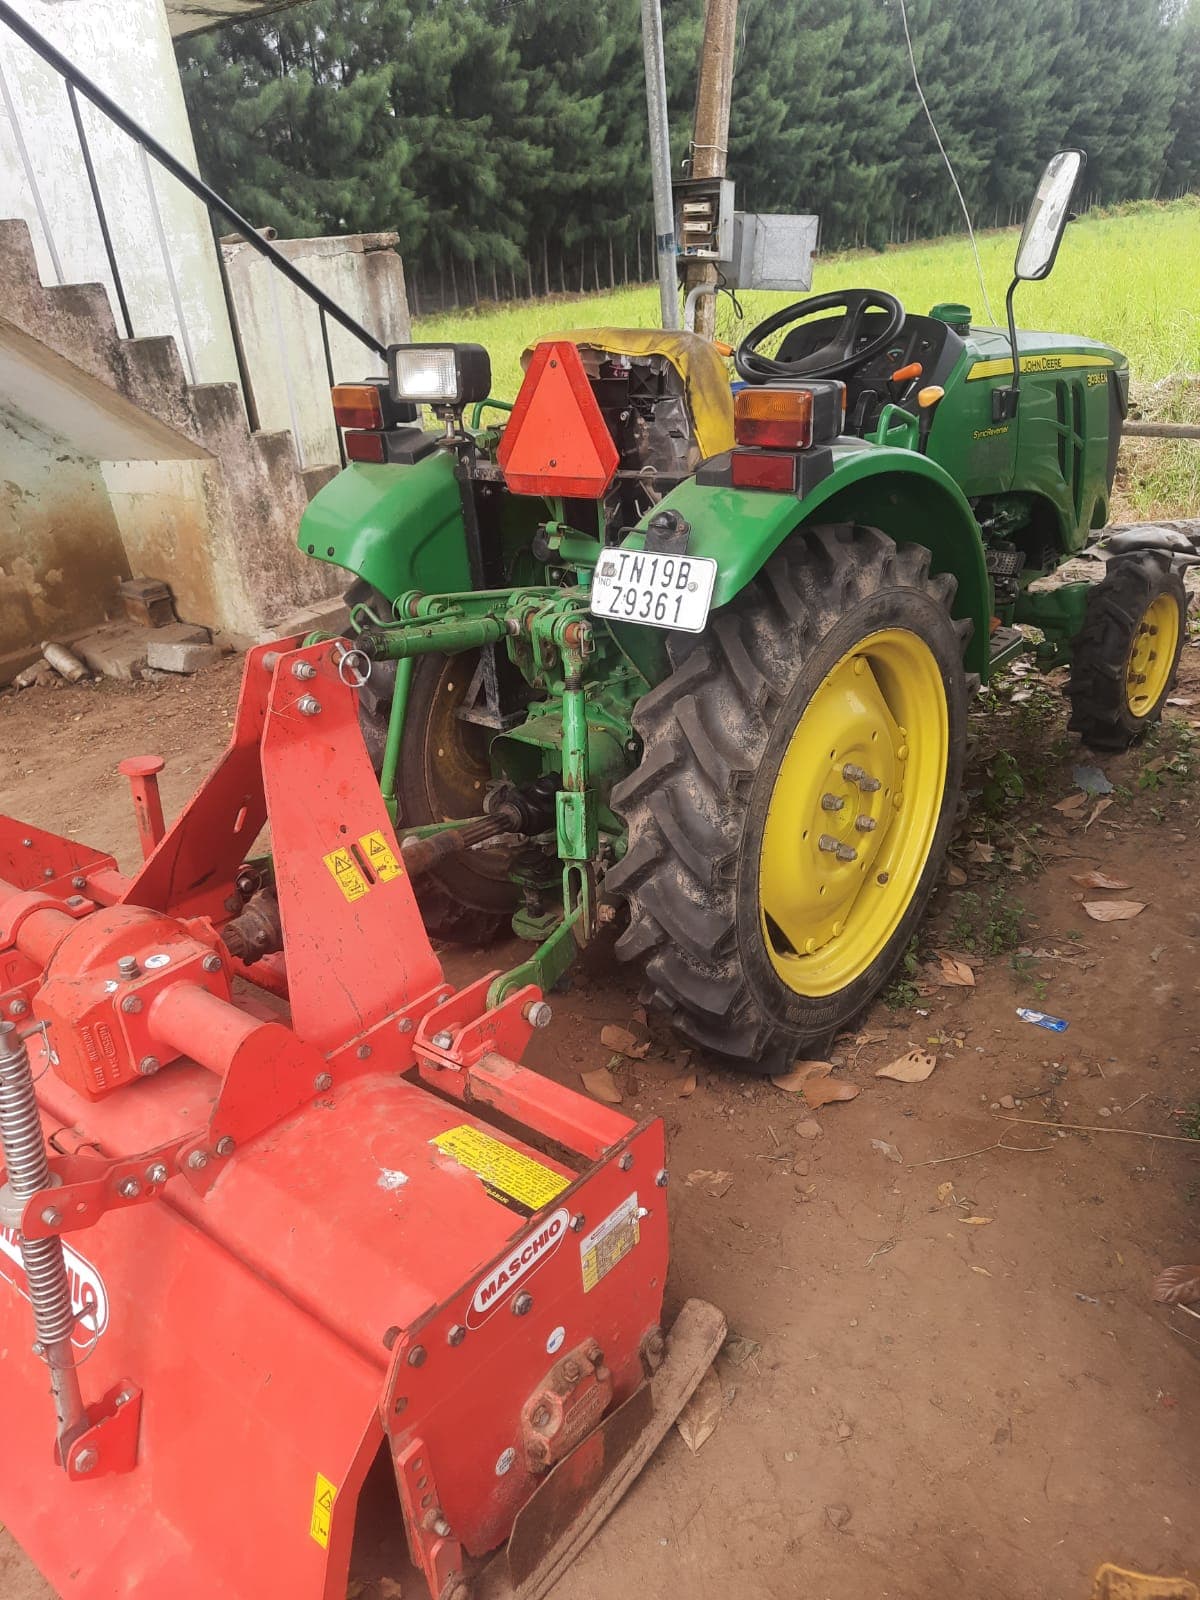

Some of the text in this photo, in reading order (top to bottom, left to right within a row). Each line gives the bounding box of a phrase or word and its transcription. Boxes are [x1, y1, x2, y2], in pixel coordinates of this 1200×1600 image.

[1023, 358, 1062, 372] JOHN DEERE
[618, 554, 691, 590] TN19B
[609, 585, 683, 623] Z9361
[479, 1219, 562, 1305] MASCHIO
